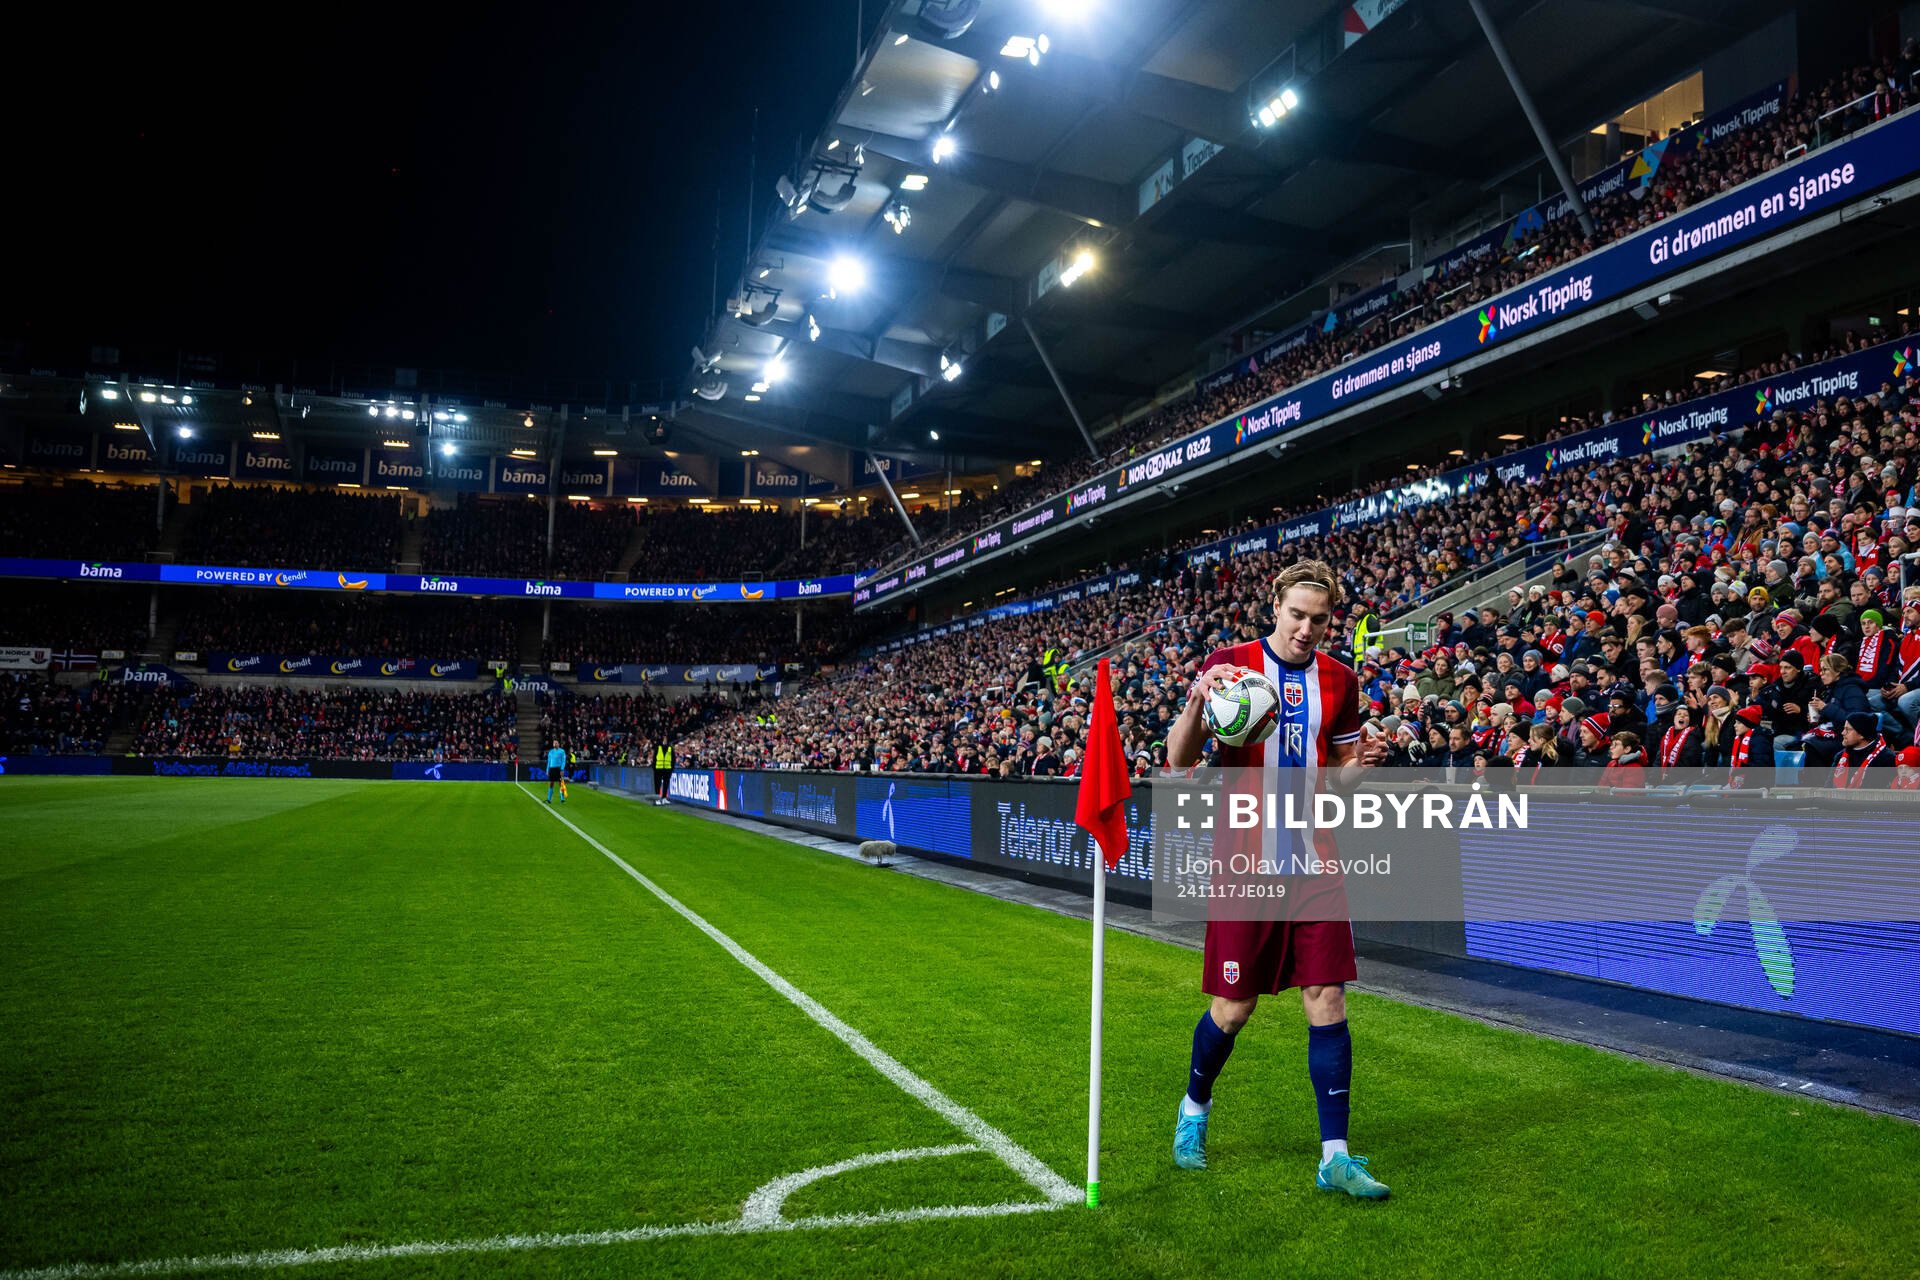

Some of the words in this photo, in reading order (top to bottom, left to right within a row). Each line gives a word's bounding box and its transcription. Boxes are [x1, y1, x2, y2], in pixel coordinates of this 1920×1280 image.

[1712, 118, 1741, 140] Norsk
[1741, 98, 1780, 124] Tipping
[1649, 236, 1668, 264] Gi
[1672, 204, 1756, 256] drømmen
[1760, 192, 1784, 218] en
[1788, 162, 1855, 211] sjanse
[1499, 294, 1538, 330] Norsk
[1538, 274, 1593, 314] Tipping
[1332, 380, 1343, 400] Gi
[1344, 364, 1390, 394] drømmen
[1391, 358, 1405, 374] en
[1406, 341, 1441, 372] sjanse
[1775, 383, 1810, 406] Norsk
[1810, 370, 1858, 397] Tipping
[1247, 417, 1270, 436] Norsk
[1270, 400, 1301, 428] Tipping
[1658, 415, 1688, 438] Norsk
[1688, 407, 1728, 430] Tipping
[107, 443, 151, 462] bam
[1559, 445, 1584, 464] Norsk
[1585, 437, 1618, 458] Tipping
[1128, 464, 1146, 485] NOR
[1165, 447, 1183, 470] KAZ
[1186, 435, 1211, 461] 03:22
[1474, 473, 1488, 487] Nor
[1496, 463, 1526, 482] Tipping
[1074, 493, 1087, 508] Norsk
[1087, 484, 1106, 506] Tipping
[1340, 512, 1356, 524] Norsk
[1285, 527, 1298, 540] Norsk
[1298, 522, 1320, 538] Tipping
[1236, 542, 1250, 553] Norsk
[1250, 537, 1267, 551] Tipping
[80, 564, 122, 578] bama
[196, 570, 256, 582] POWERED
[258, 572, 274, 582] BY
[282, 571, 308, 582] Bendit
[420, 577, 458, 592] bama
[525, 582, 562, 596] bama
[625, 587, 675, 597] POWERED
[678, 588, 690, 597] BY
[698, 584, 717, 596] Bendit
[798, 582, 822, 594] bama
[234, 656, 261, 668] Bendit
[286, 658, 312, 670] Bendit
[338, 659, 362, 671] Bendit
[437, 661, 461, 674] Bendit
[124, 666, 168, 682] bama
[600, 666, 623, 678] Bendit
[1228, 709, 1247, 734] LEAGUE
[997, 800, 1080, 868] Telenor.
[1162, 829, 1213, 890] me
